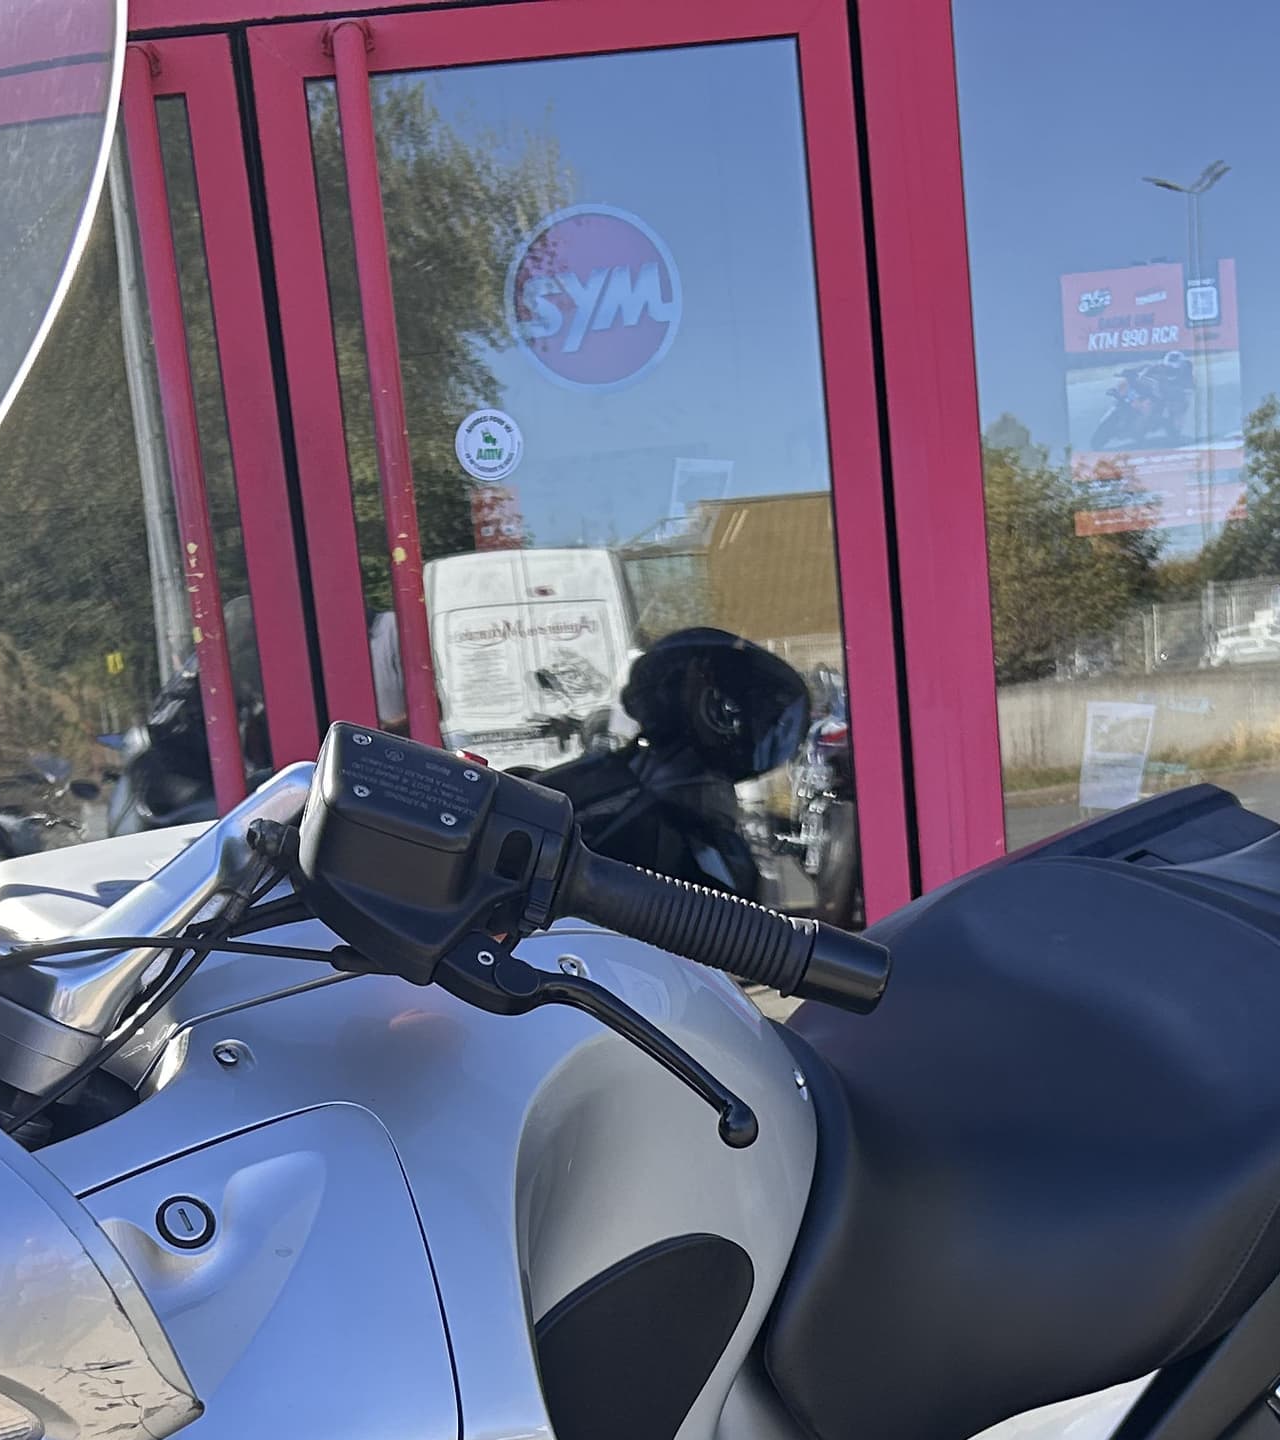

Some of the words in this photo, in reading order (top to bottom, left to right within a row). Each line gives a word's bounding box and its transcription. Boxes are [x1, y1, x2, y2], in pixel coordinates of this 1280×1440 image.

[521, 262, 673, 353] SYM
[1088, 332, 1119, 350] KTM
[1121, 328, 1147, 347] 990
